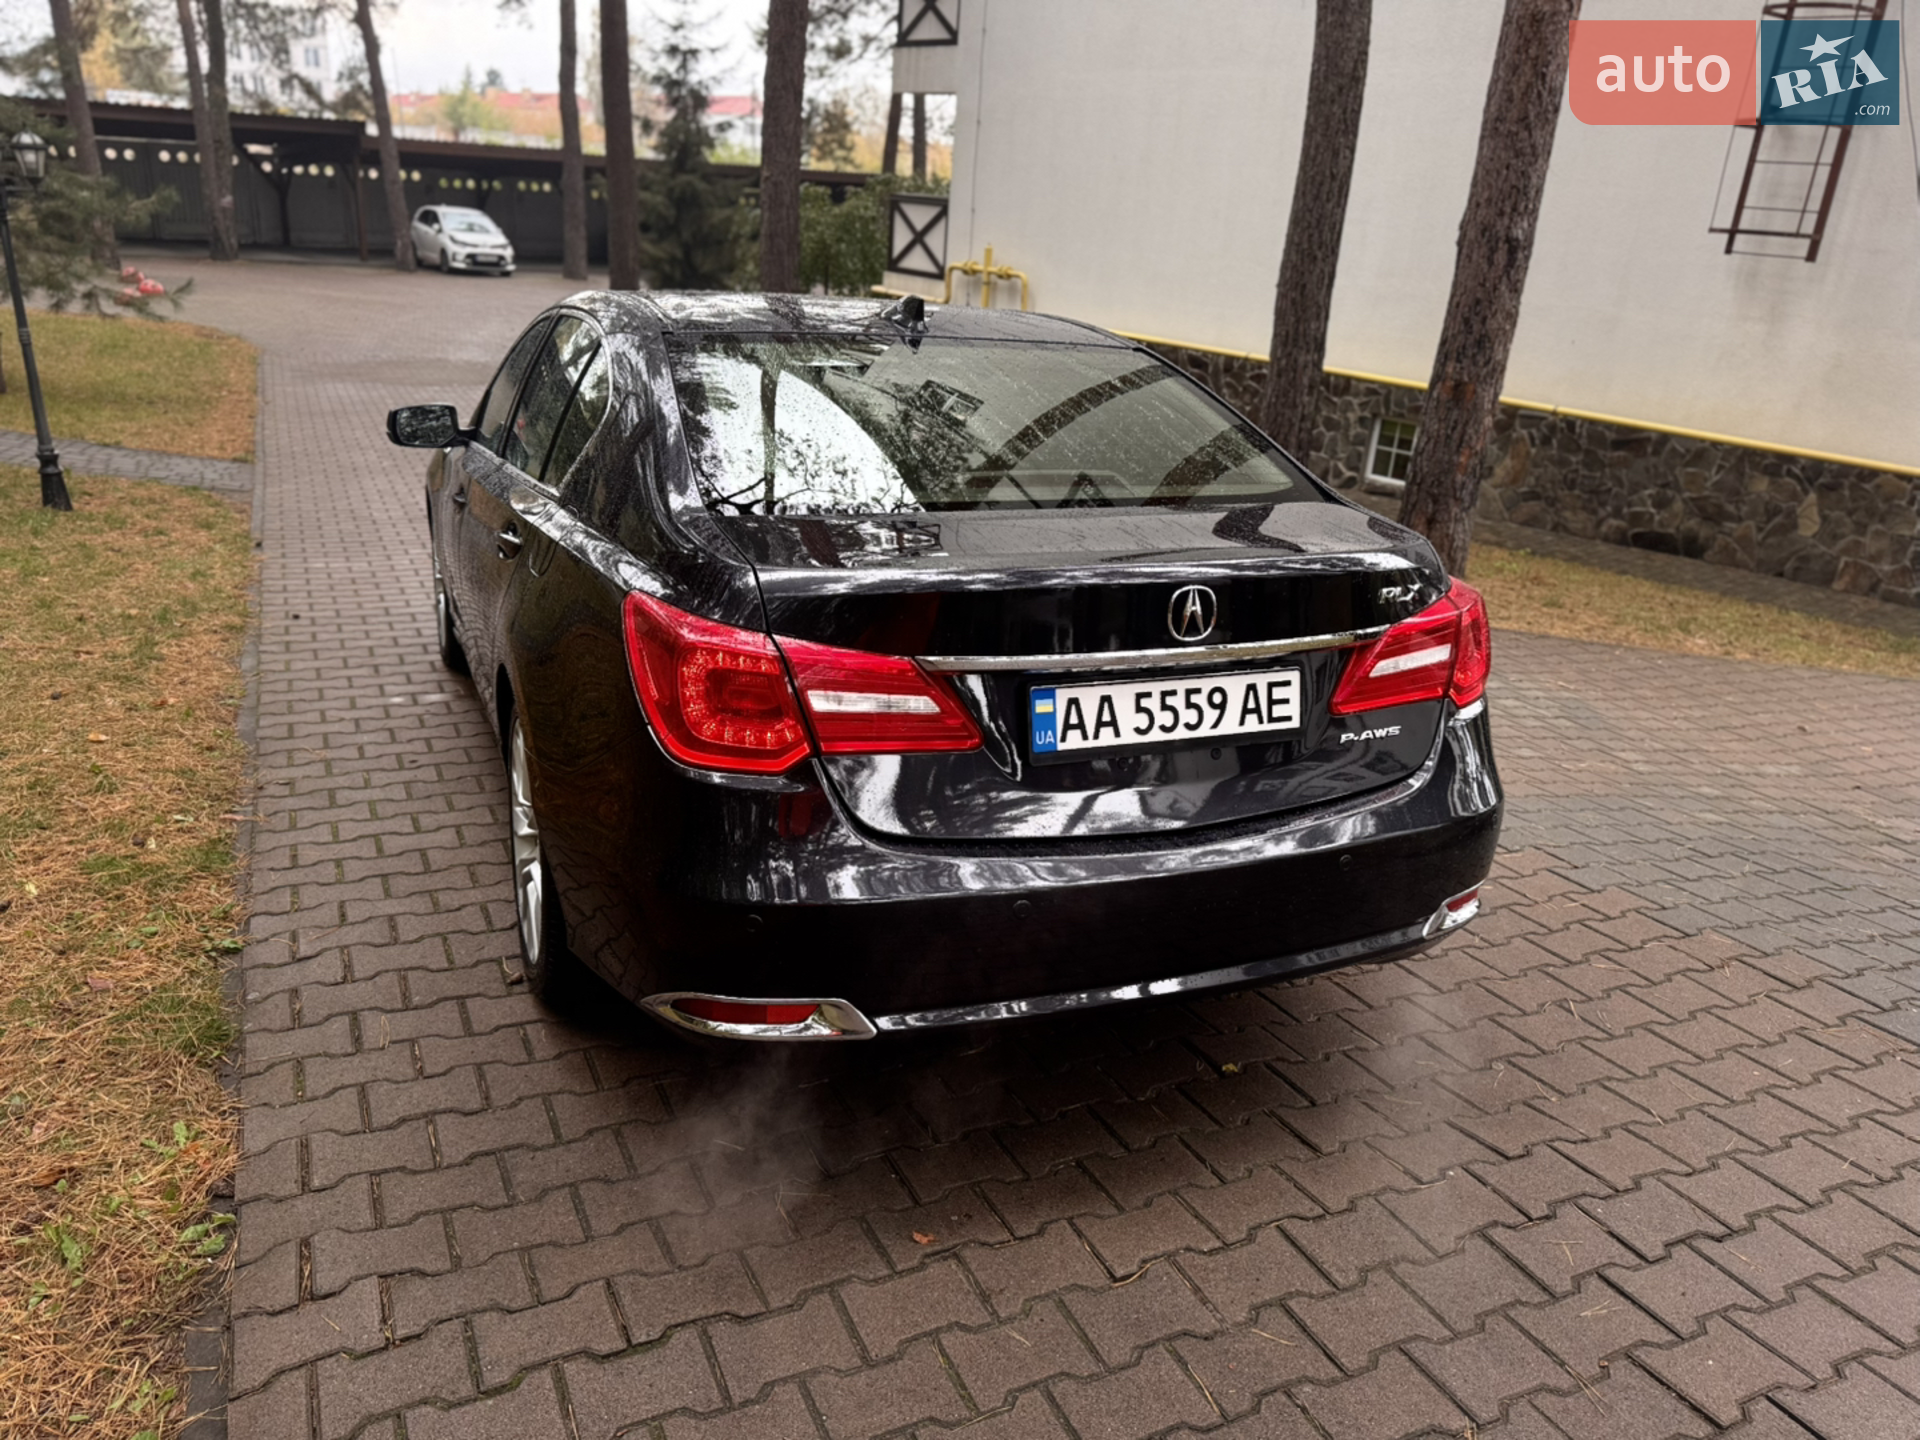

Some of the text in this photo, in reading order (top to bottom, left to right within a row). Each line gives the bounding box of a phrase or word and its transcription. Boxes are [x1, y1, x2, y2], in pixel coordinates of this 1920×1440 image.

[1059, 680, 1293, 743] AA 5559 AE
[1035, 730, 1055, 745] UA
